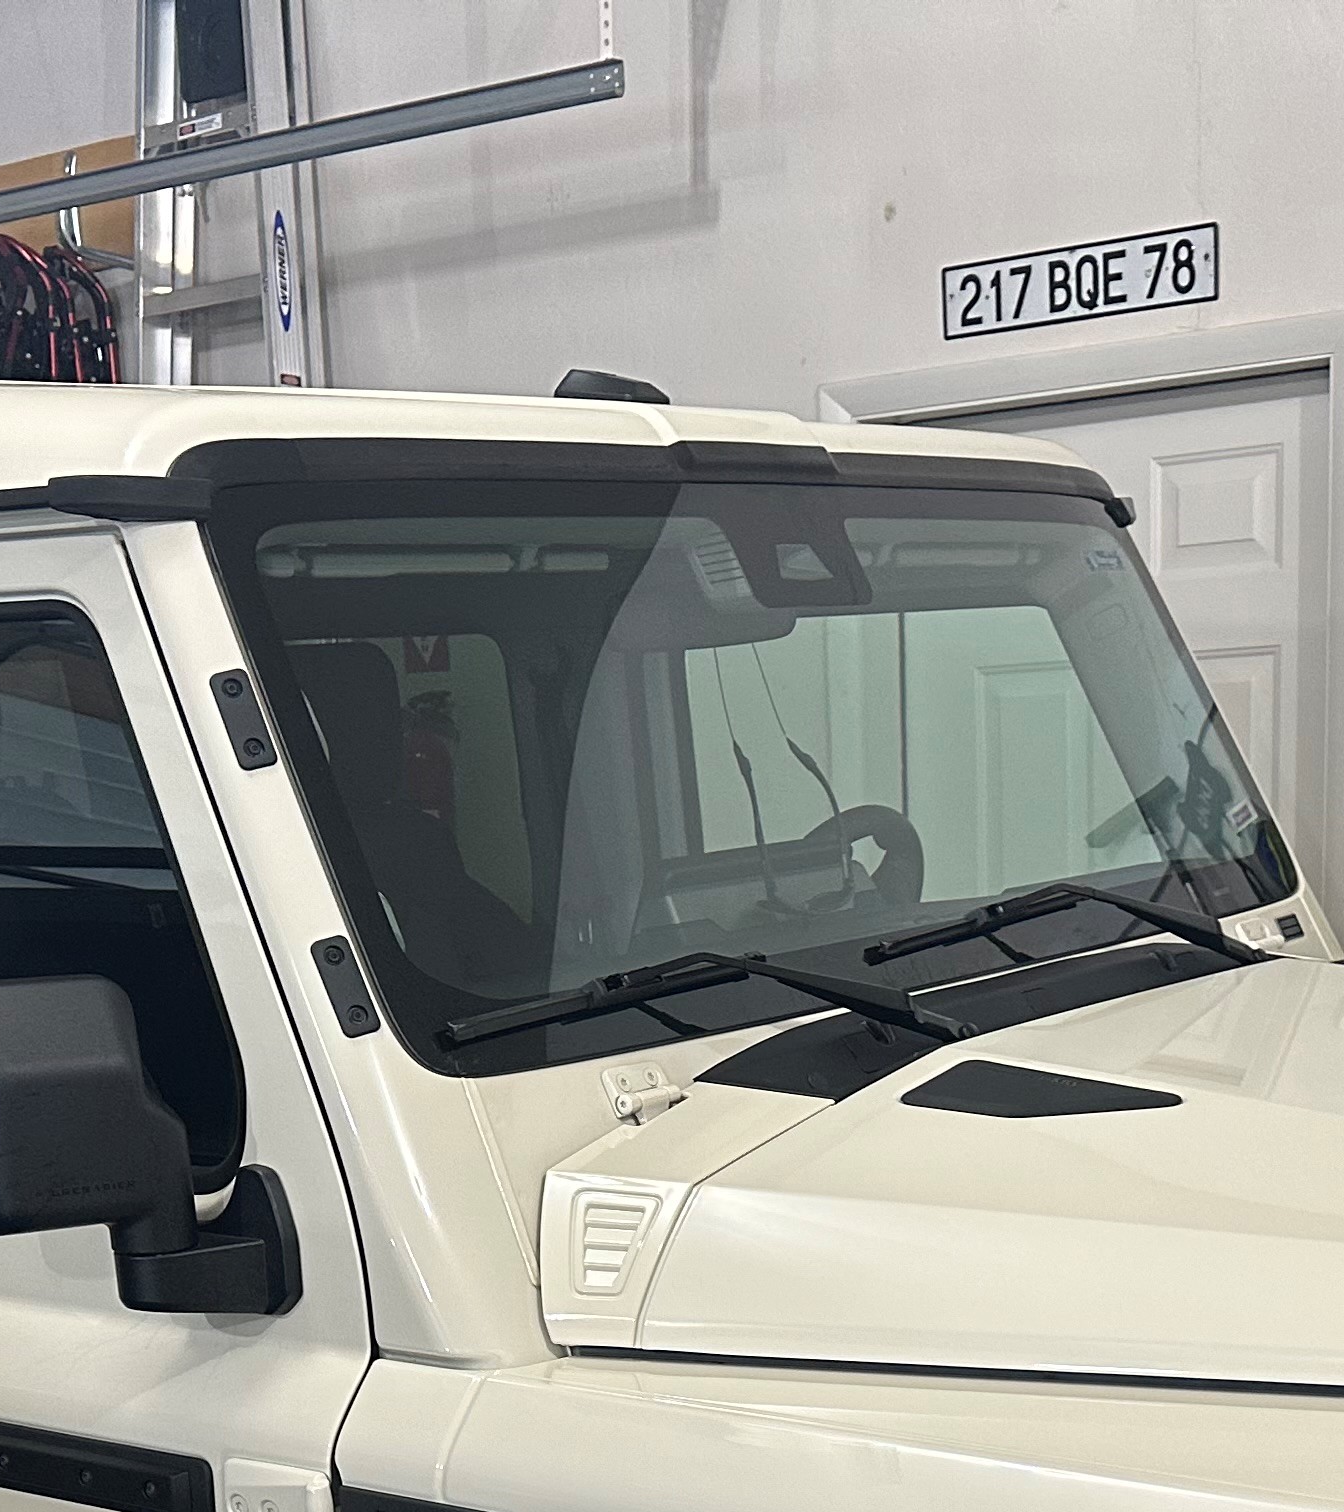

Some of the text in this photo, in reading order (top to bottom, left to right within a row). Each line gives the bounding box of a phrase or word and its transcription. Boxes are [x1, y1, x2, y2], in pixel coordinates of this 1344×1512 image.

[277, 235, 289, 306] WERNER
[960, 239, 1195, 327] 217 BQE 78
